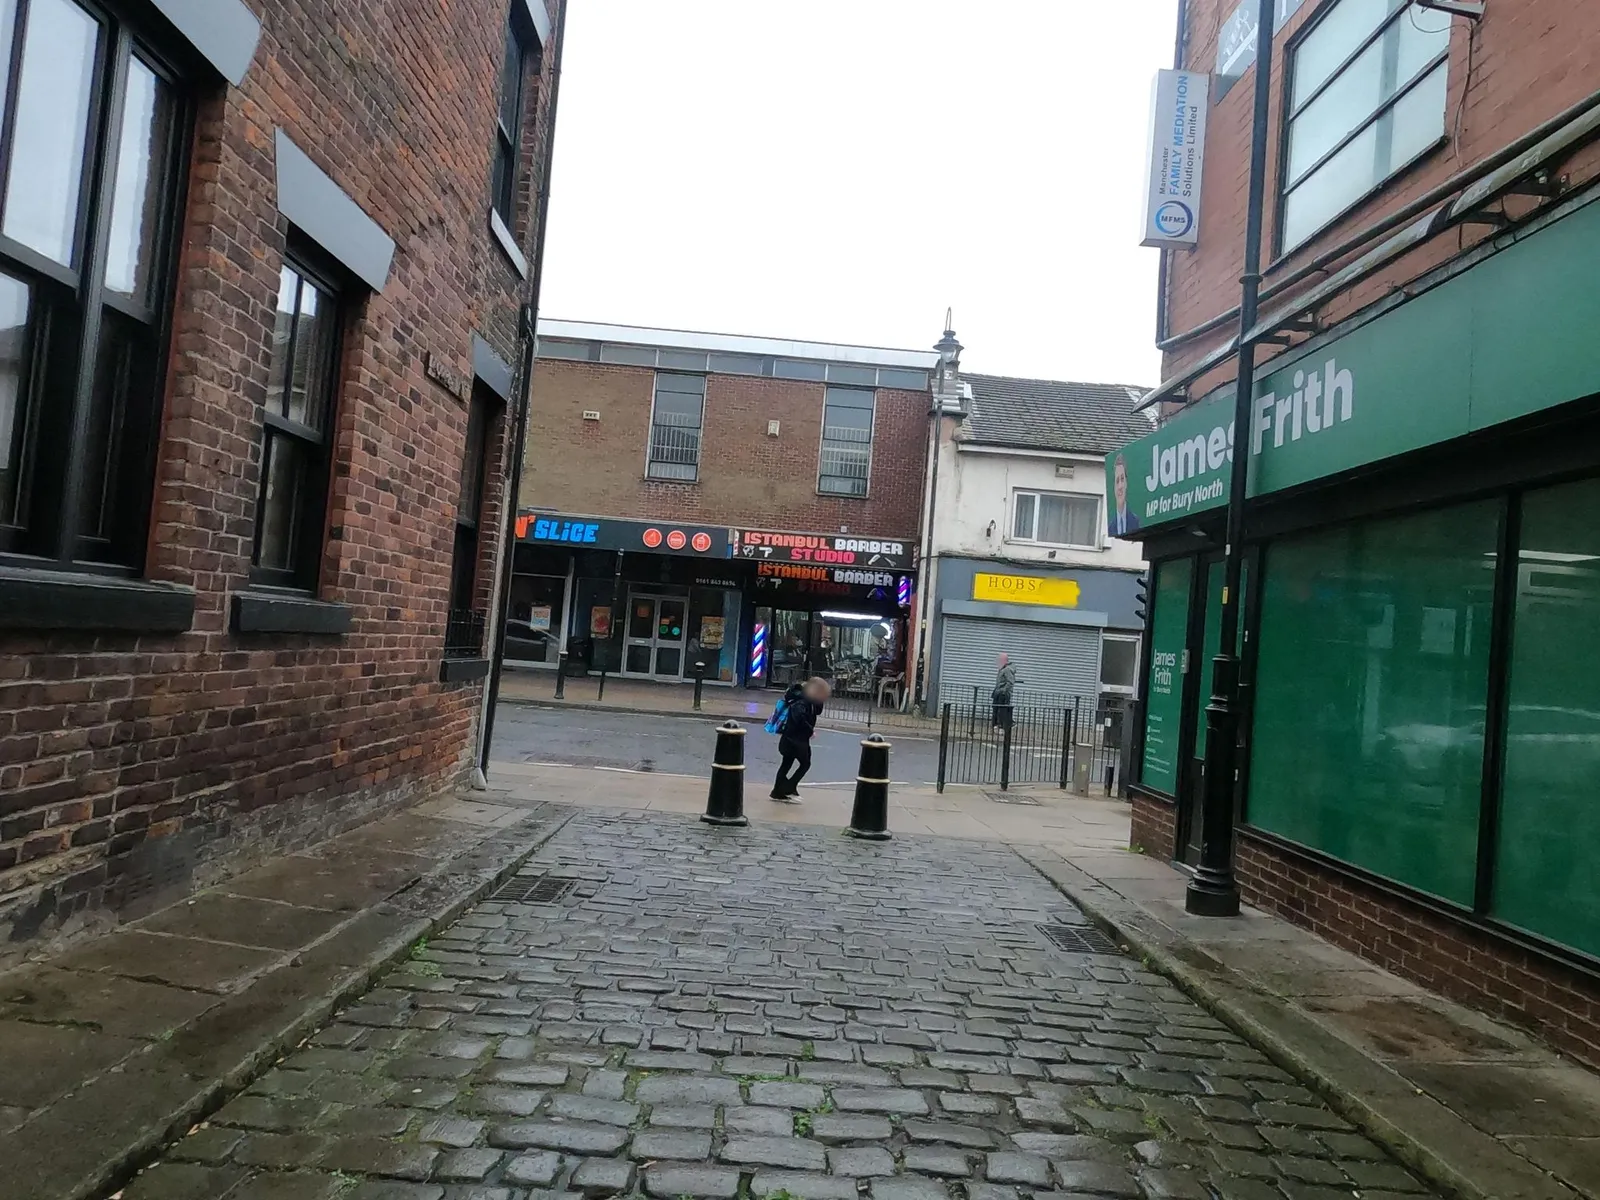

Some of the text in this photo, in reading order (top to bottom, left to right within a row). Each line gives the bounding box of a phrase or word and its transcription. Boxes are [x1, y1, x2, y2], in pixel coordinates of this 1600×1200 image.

[1169, 75, 1189, 196] FAMILY MEDIATION
[1182, 105, 1198, 197] Solutions Limited
[1159, 146, 1169, 195] Manchester
[1161, 215, 1186, 224] MFMS
[1253, 359, 1353, 455] Frith
[1146, 478, 1223, 518] MP for Bury North
[744, 532, 903, 555] ISTANBUL BARBER
[791, 549, 856, 564] STUDIO
[758, 564, 893, 587] ISTANBUL BARBER
[1153, 649, 1175, 668] James
[1154, 667, 1172, 685] Frith
